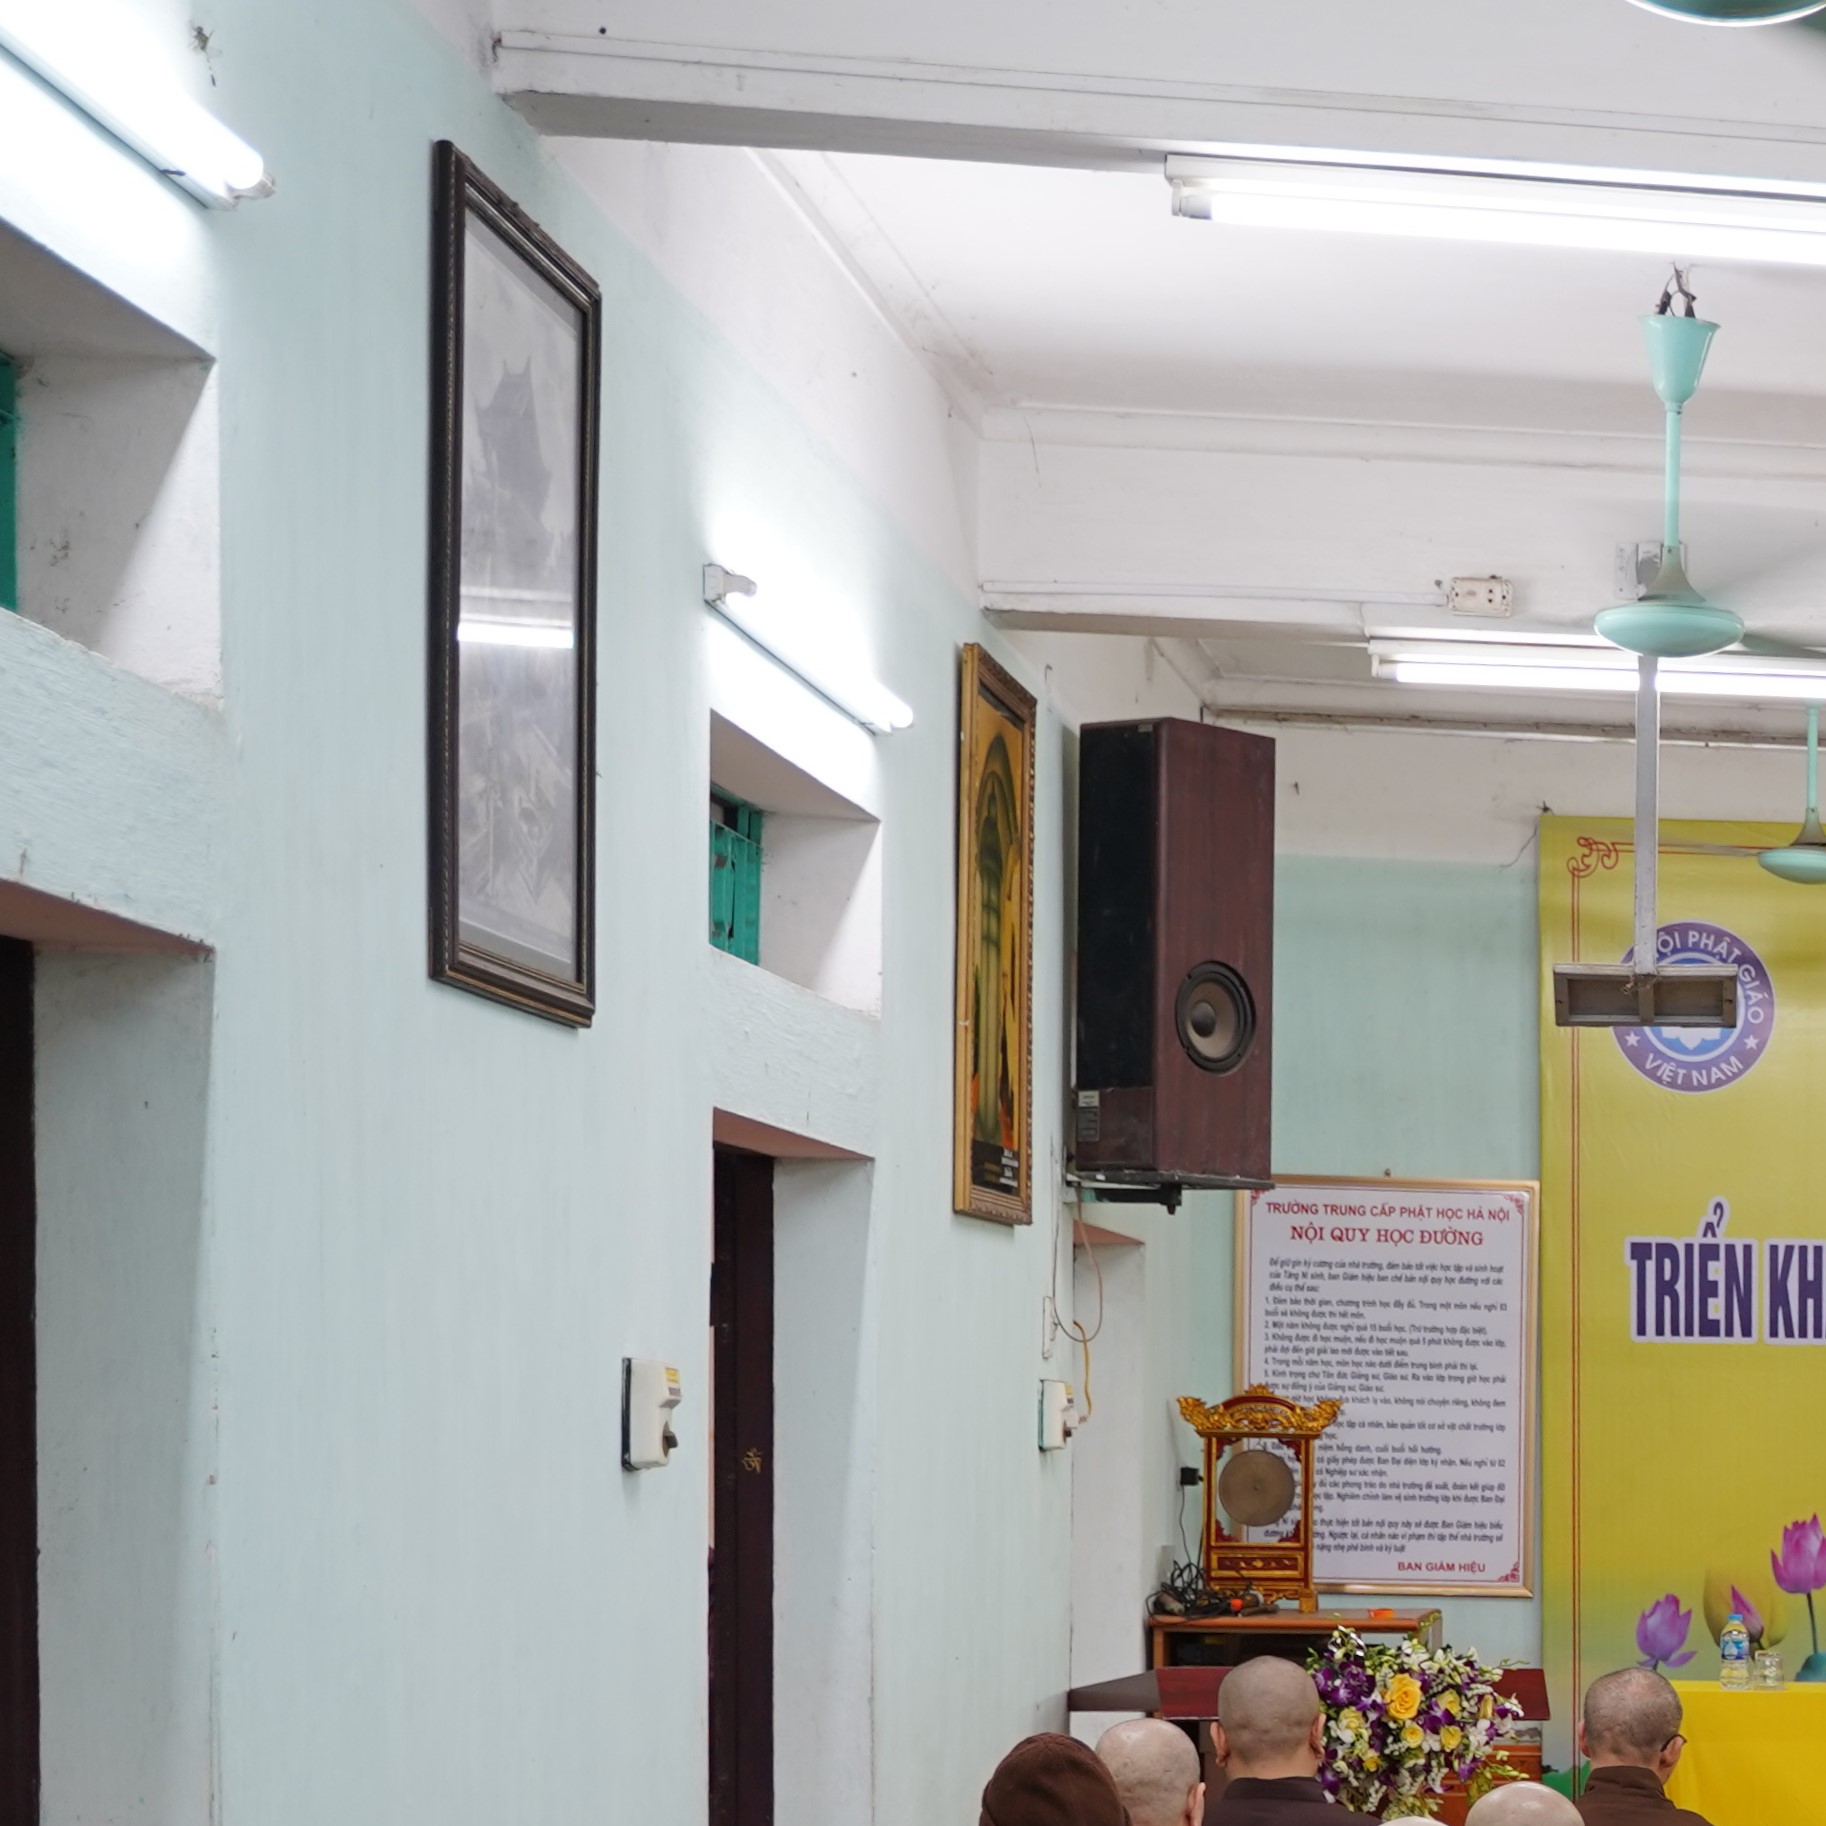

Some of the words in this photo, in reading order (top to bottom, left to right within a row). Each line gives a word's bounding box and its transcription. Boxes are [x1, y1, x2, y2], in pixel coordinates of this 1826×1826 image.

[1656, 930, 1681, 957] ỘI
[1688, 930, 1741, 962] PHẬT
[1738, 964, 1769, 1025] GIÁO
[1644, 1053, 1688, 1085] VIỆT
[1692, 1055, 1744, 1087] NAM
[1266, 1199, 1319, 1215] TRƯỜNG
[1323, 1204, 1366, 1217] TRUNG
[1370, 1201, 1396, 1217] CẤP
[1399, 1204, 1432, 1221] PHẬT
[1437, 1208, 1463, 1221] HỌC
[1467, 1206, 1485, 1220] HÀ
[1488, 1207, 1511, 1224] NỘI
[1291, 1221, 1325, 1244] NỘI
[1330, 1226, 1370, 1242] QUY
[1376, 1228, 1414, 1247] HỌC
[1420, 1226, 1483, 1246] ĐƯỜNG
[1630, 1202, 1753, 1339] TRIỂN
[1398, 1562, 1422, 1571] BAN
[1426, 1560, 1455, 1572] GIÁM
[1459, 1561, 1486, 1574] HIỆU
